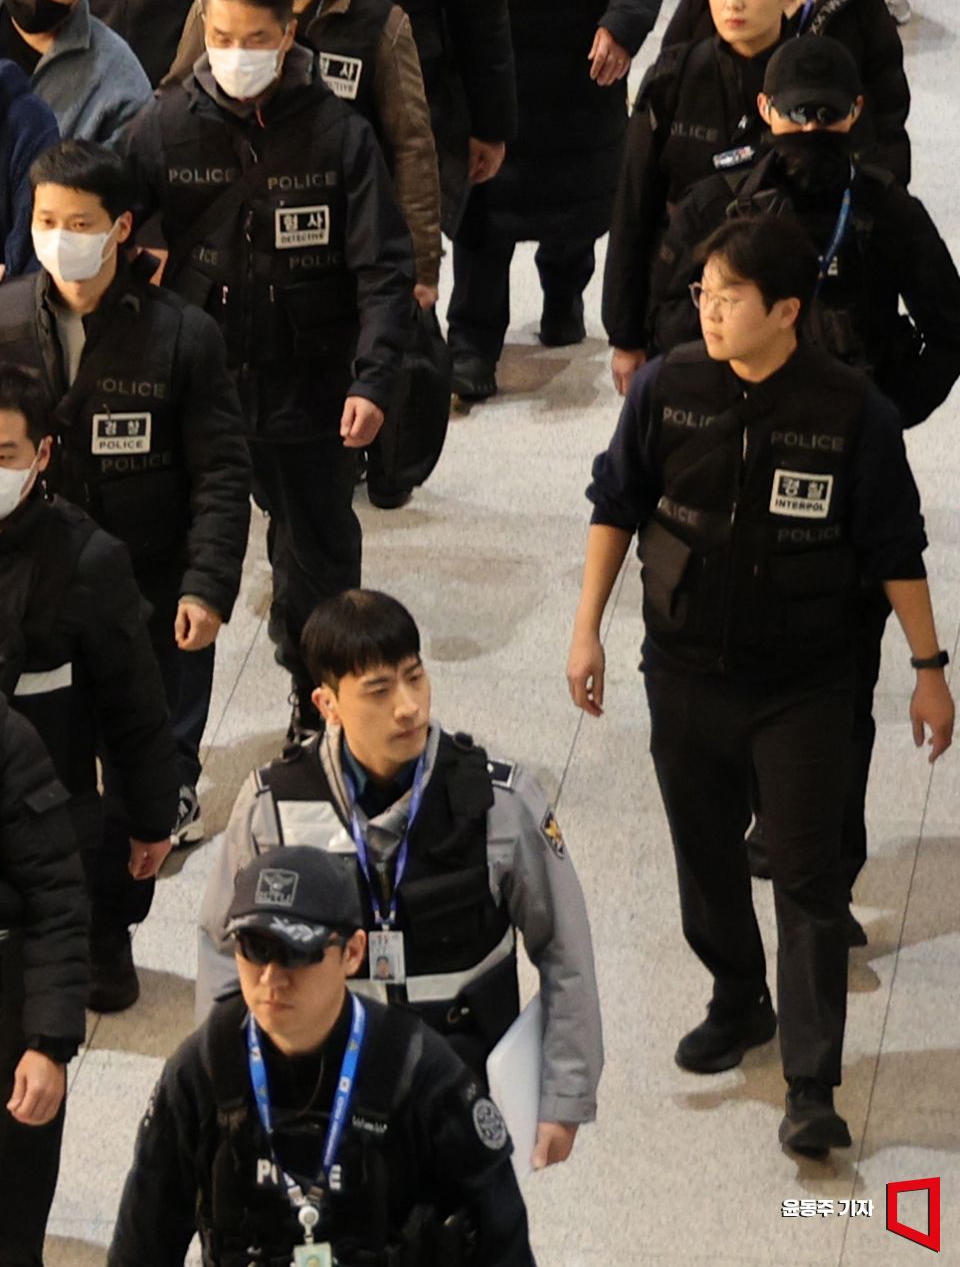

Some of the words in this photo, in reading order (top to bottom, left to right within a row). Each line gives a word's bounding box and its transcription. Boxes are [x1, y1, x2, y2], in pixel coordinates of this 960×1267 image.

[168, 167, 236, 183] POLICE
[267, 172, 337, 190] POLICE
[280, 232, 325, 244] DETECTIVE
[99, 440, 144, 451] POLICE
[771, 431, 844, 452] POLICE
[774, 499, 825, 512] INTERPOL
